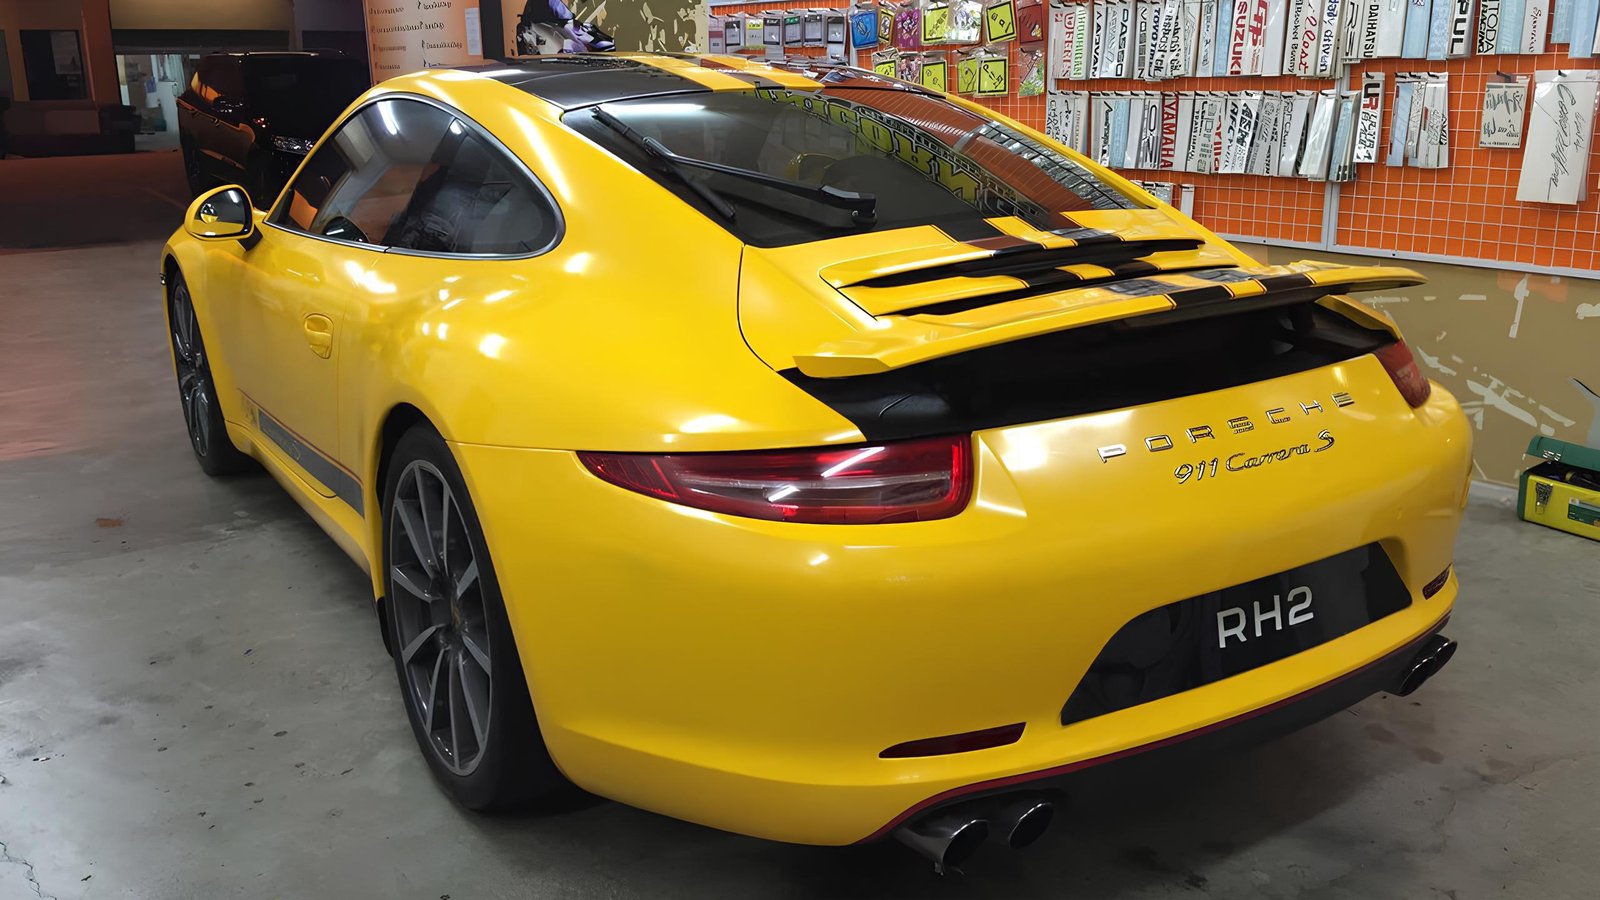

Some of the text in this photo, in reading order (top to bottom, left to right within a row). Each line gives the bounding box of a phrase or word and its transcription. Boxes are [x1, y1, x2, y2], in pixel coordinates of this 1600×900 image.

[1230, 1, 1248, 75] SUZUKI
[1363, 4, 1380, 58] DAIHATSU
[1483, 3, 1499, 53] TODA
[1160, 100, 1178, 169] YAMAHA
[1097, 392, 1354, 463] PORSCHE
[1174, 429, 1335, 484] 911 Carrera S
[1216, 585, 1315, 649] RH2
